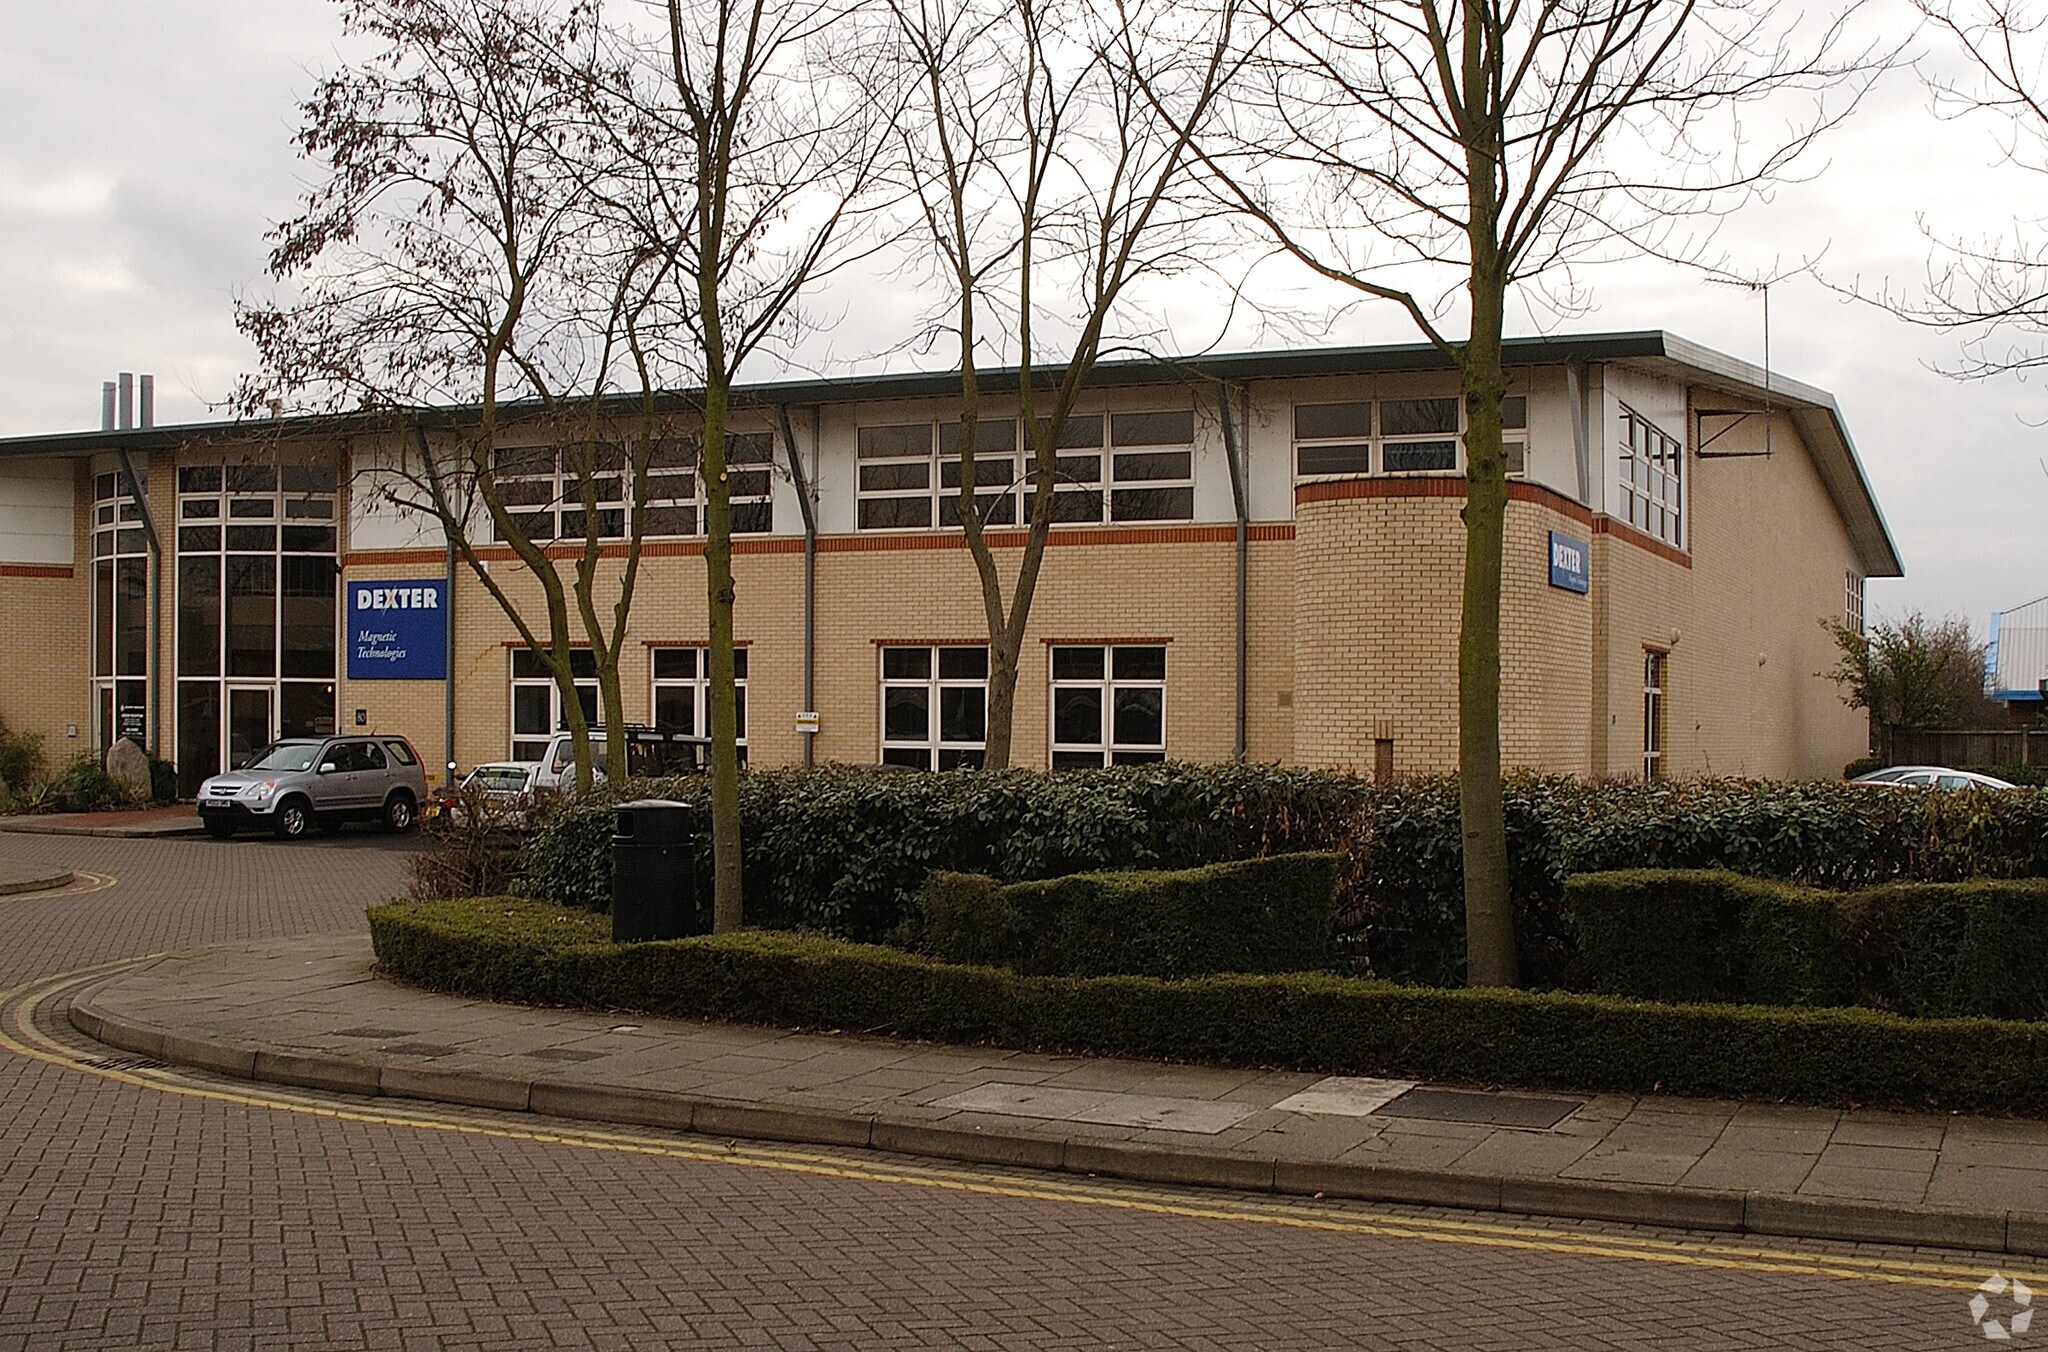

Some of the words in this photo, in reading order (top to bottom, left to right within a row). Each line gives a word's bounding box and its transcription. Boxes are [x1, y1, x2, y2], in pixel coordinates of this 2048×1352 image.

[1553, 542, 1581, 574] DEXTER
[357, 588, 438, 609] DEXTER
[358, 630, 397, 645] Magnetic
[358, 646, 406, 661] Technologies
